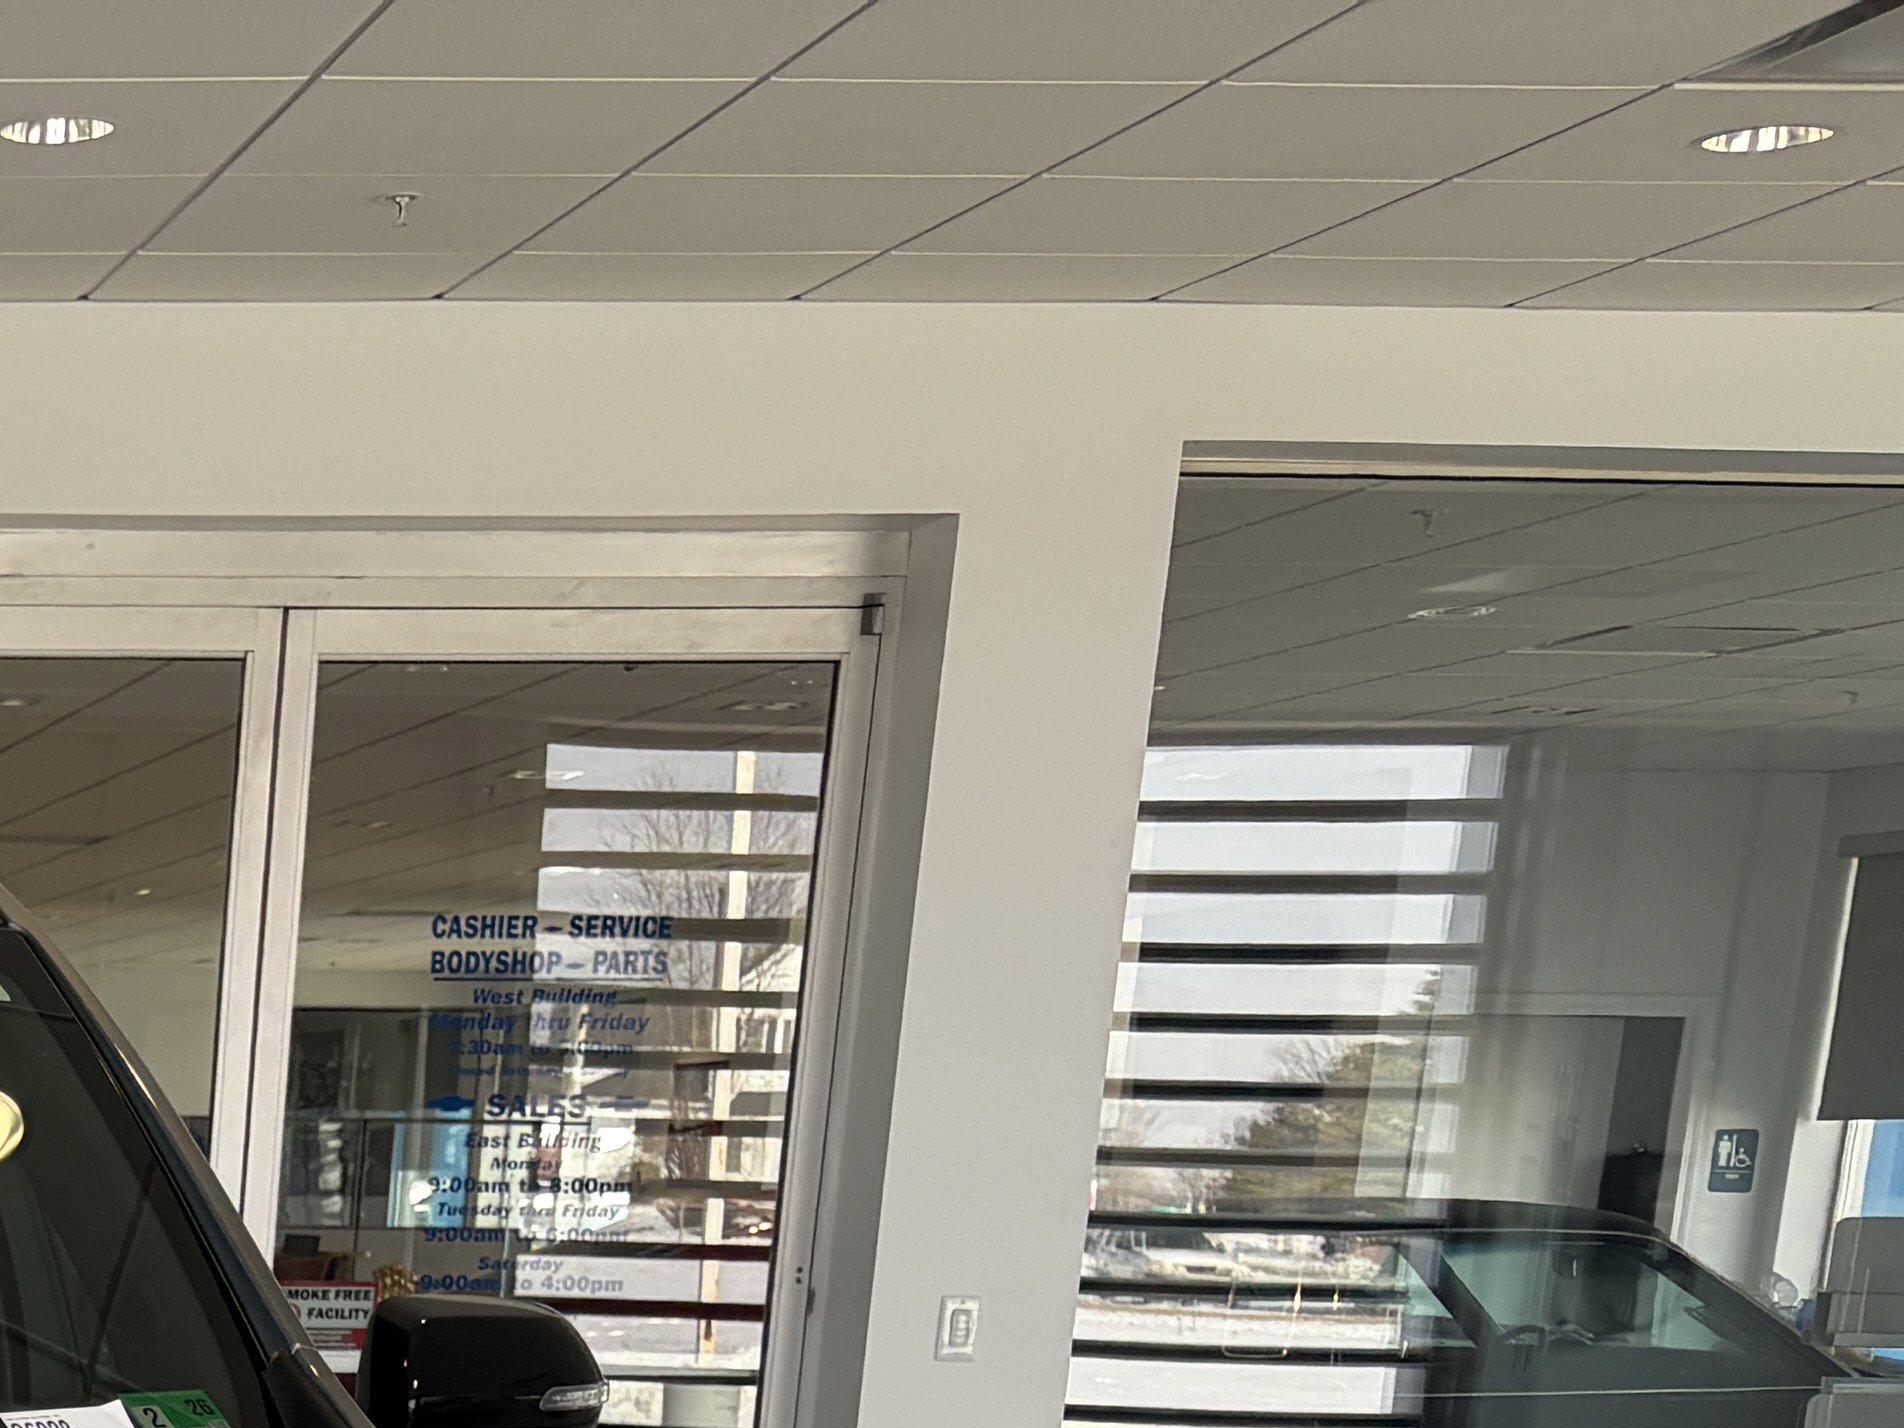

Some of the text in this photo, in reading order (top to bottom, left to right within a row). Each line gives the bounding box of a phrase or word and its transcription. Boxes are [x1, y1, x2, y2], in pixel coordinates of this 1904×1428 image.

[431, 914, 675, 940] CASHIER SERVICE
[431, 950, 669, 975] BODYSHOP PARTS
[473, 988, 618, 1008] West Building
[526, 1013, 571, 1030] hru
[578, 1012, 651, 1034] Friday
[486, 1094, 587, 1118] SALES
[465, 1132, 509, 1149] East
[428, 1177, 510, 1194] 9:00am
[436, 1202, 512, 1219] Tuesday
[561, 1203, 621, 1221] Friday
[477, 1256, 564, 1274] Saturday
[542, 1275, 625, 1294] 4:00pm
[287, 1288, 372, 1301] MOKE FREE
[307, 1307, 370, 1320] FACILITY
[185, 1398, 216, 1416] 26
[143, 1407, 167, 1428] 2
